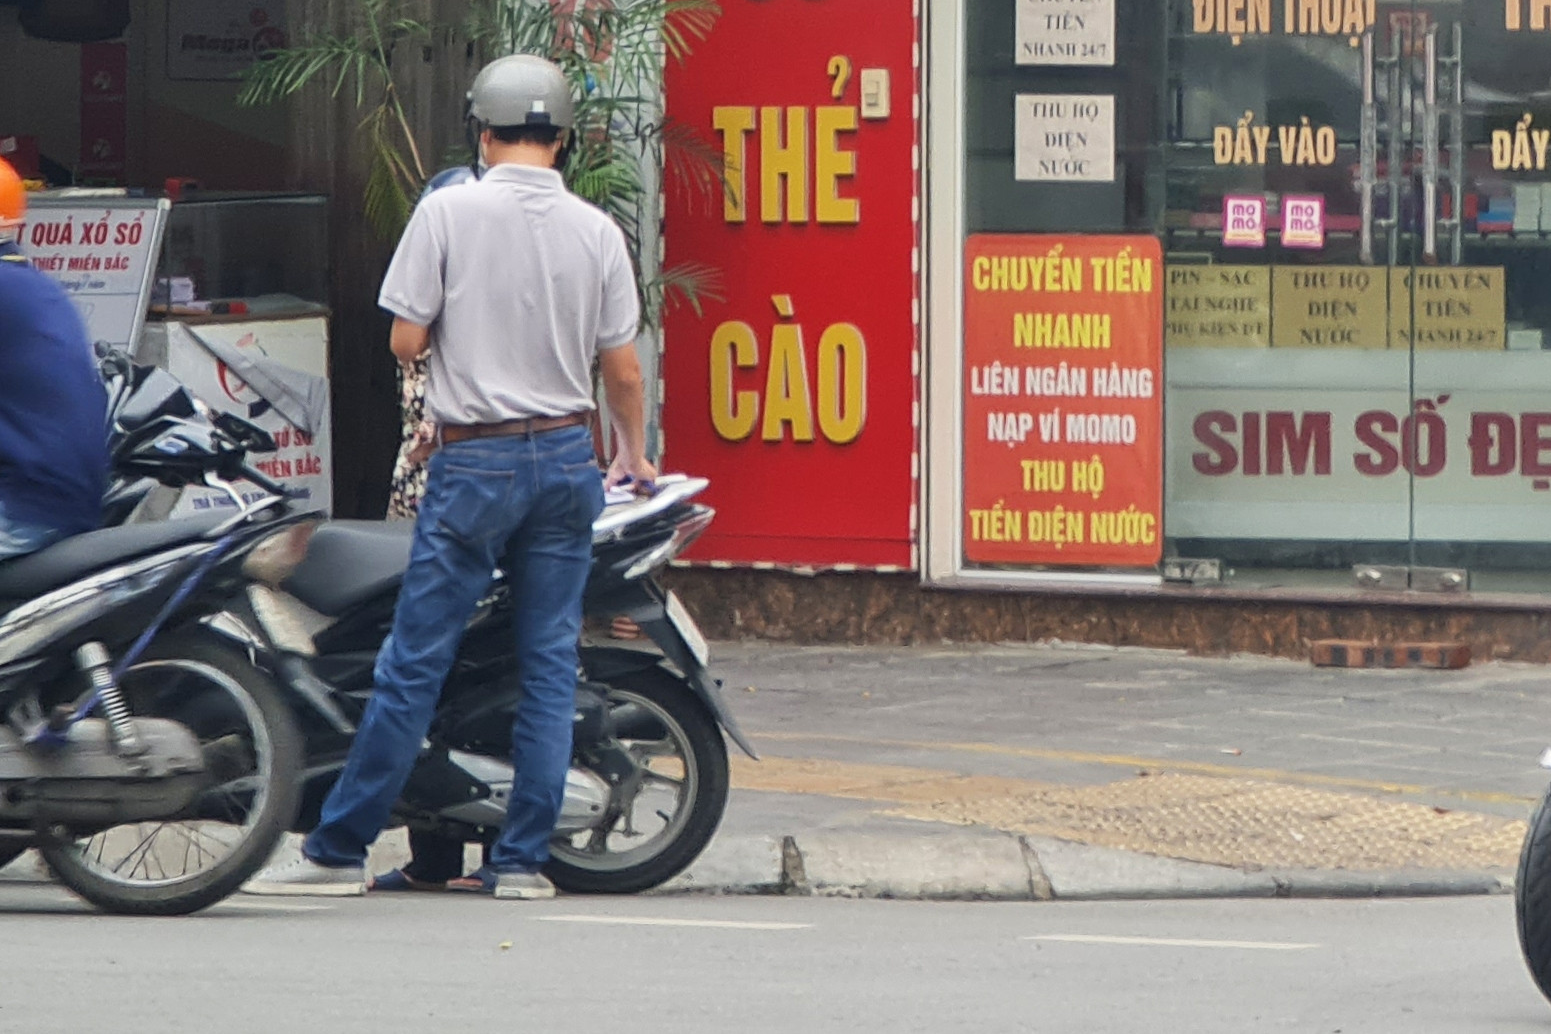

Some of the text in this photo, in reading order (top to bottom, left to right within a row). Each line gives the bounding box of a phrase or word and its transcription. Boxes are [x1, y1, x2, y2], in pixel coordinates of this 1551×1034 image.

[712, 55, 860, 224] THẺ
[1214, 110, 1336, 165] ĐẨY VÀO
[1491, 112, 1551, 171] ĐẨY
[31, 215, 74, 247] QUẢ
[78, 210, 111, 245] XỔ
[1013, 313, 1112, 349] NHANH
[710, 294, 867, 444] CÀO
[971, 360, 1154, 398] LIÊN NGÂN HÀNG
[987, 412, 1034, 448] NẠP
[1066, 414, 1137, 445] MOMO
[1191, 409, 1332, 477] SIM
[1353, 393, 1452, 477] SỐ
[1020, 454, 1106, 499] THU HỘ
